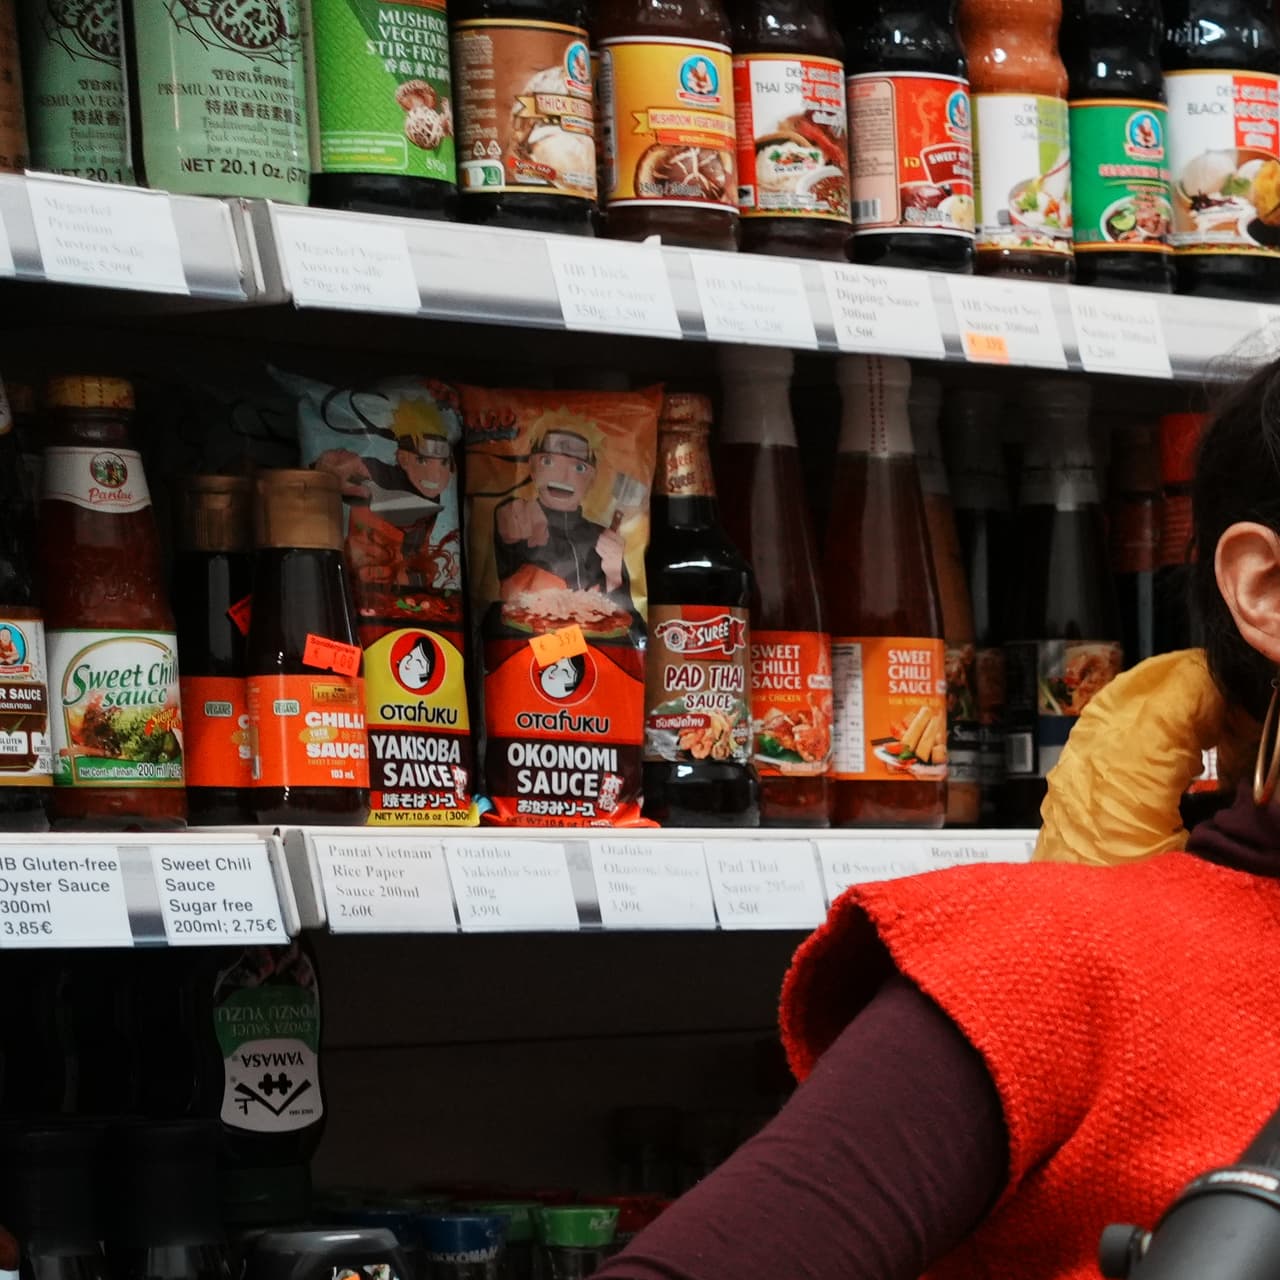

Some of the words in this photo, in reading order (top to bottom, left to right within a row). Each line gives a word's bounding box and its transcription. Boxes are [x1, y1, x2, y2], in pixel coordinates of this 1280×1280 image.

[182, 159, 214, 173] NET
[221, 160, 257, 176] 20.1
[833, 269, 860, 283] Thai
[836, 289, 885, 308] Dipping
[696, 621, 730, 646] SUREE
[751, 644, 800, 660] SWEET
[887, 649, 932, 664] SWEET
[751, 660, 800, 675] CHILLI
[887, 664, 931, 680] CHILLI
[62, 663, 143, 705] Sweet
[664, 664, 704, 692] PAD
[709, 665, 745, 692] THAI
[751, 674, 802, 690] SAUCE
[10, 688, 42, 702] SAUCE
[888, 680, 932, 696] SAUCE
[102, 688, 168, 708] sauce
[685, 694, 732, 710] SAUCE
[274, 701, 299, 714] VEGANS
[305, 711, 364, 730] CHILLI
[371, 735, 460, 763] YAKISOBA
[507, 742, 618, 772] OKONOMI
[383, 762, 455, 788] SAUCE
[517, 769, 599, 798] SAUCE
[383, 792, 457, 808] 焼そばソース
[517, 799, 596, 817] お好みソース
[375, 811, 392, 821] NET
[432, 813, 442, 821] oz
[328, 844, 373, 859] Pantai
[375, 845, 433, 860] Vietnam
[22, 856, 118, 872] Gluten-free
[161, 857, 211, 872] Sweet
[215, 856, 252, 871] Chili
[332, 863, 363, 879] Rice
[365, 865, 406, 882] Paper
[58, 878, 110, 893] Sauce
[165, 878, 215, 893] Sauce
[335, 883, 377, 898] Sauce
[378, 884, 421, 900] 200ml
[0, 899, 51, 914] 300ml
[169, 898, 219, 916] Sugar
[222, 897, 253, 913] free
[4, 921, 53, 936] 3,85€
[173, 919, 229, 935] 200ml;
[231, 917, 278, 934] 2,75€
[241, 1051, 305, 1068] YAMASA
